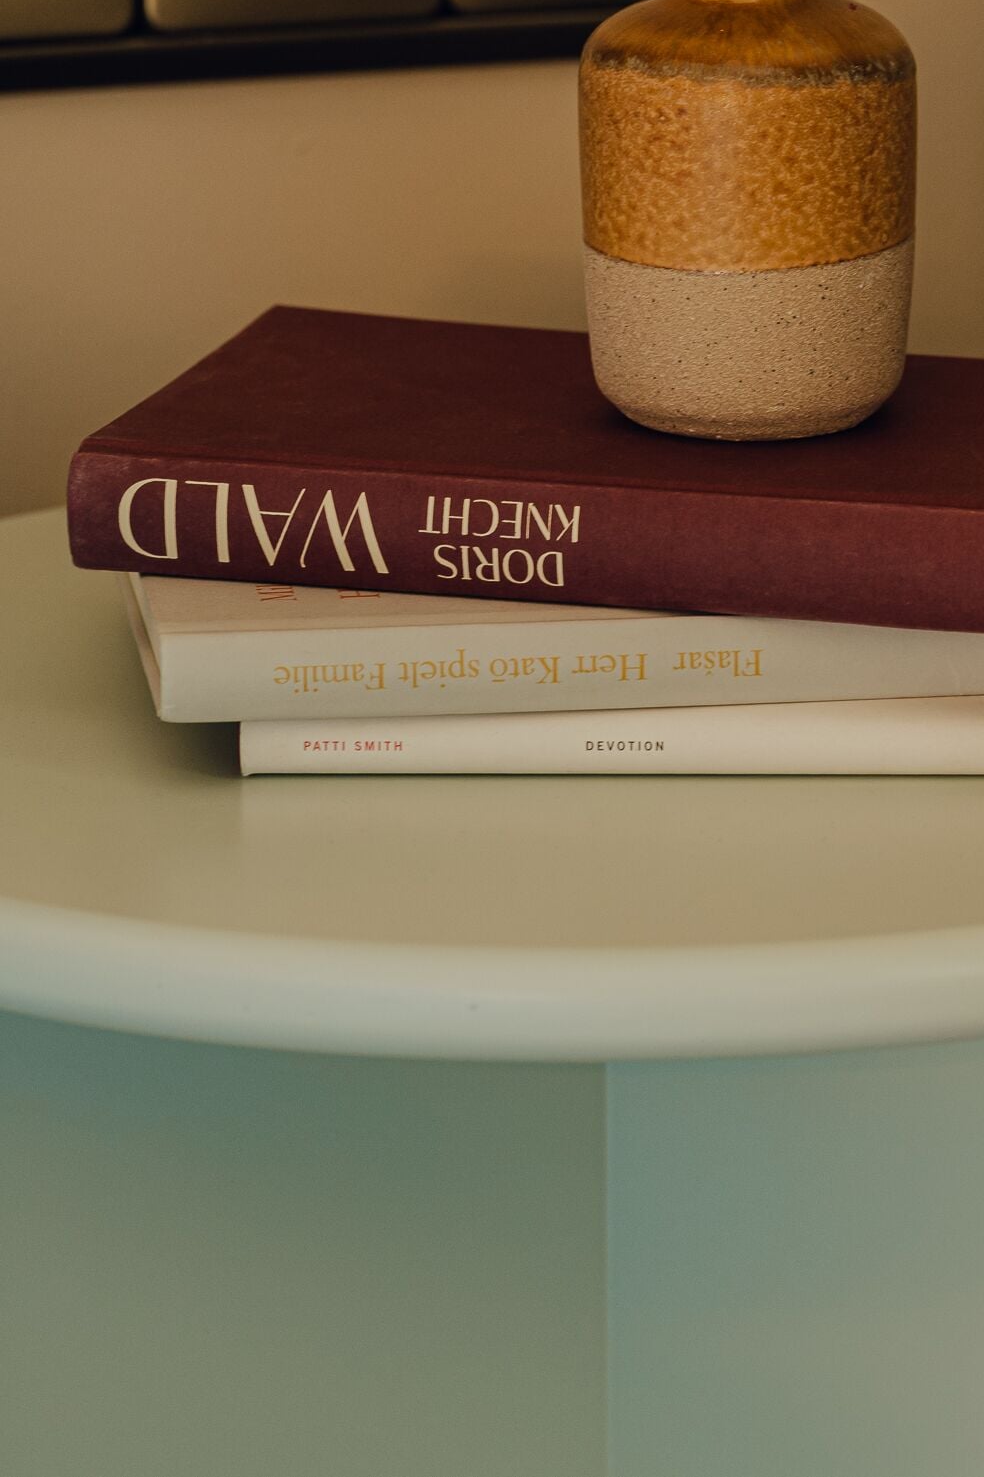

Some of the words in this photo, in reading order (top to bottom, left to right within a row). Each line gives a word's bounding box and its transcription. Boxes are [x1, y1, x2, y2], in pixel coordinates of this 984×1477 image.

[118, 477, 389, 575] WALD
[418, 494, 582, 543] KNECHT
[433, 544, 565, 587] DORIS
[273, 661, 387, 693] Familie
[399, 648, 479, 689] spielt
[489, 655, 560, 684] Katō
[571, 652, 647, 682] Herr
[673, 649, 764, 678] Flašar
[303, 740, 346, 752] PATTI
[354, 740, 403, 752] SMITH
[585, 740, 665, 752] DEVOTION
